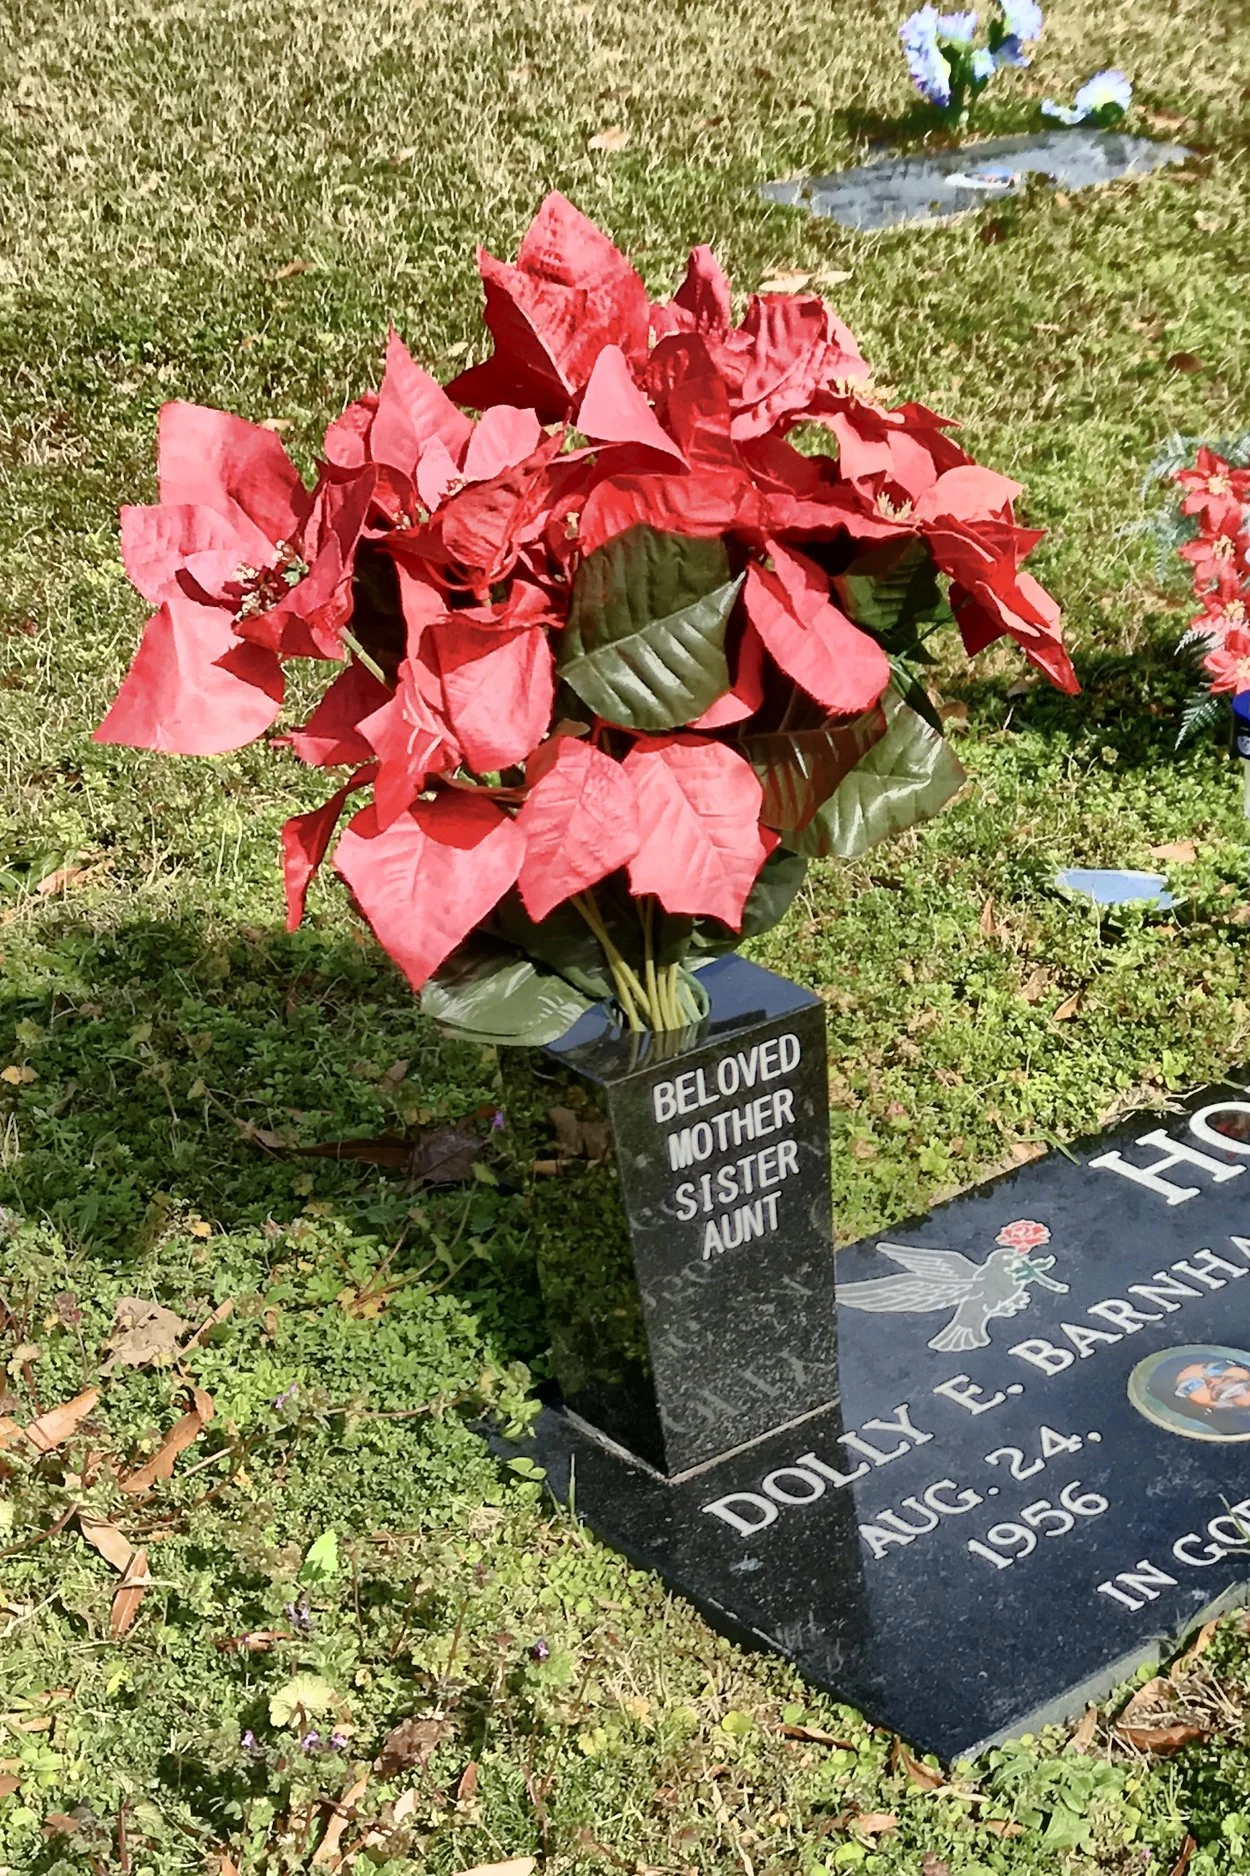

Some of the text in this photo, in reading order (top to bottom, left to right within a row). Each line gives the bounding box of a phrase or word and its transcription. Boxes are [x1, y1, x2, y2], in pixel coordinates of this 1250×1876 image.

[652, 1032, 801, 1124] BELOVED
[668, 1088, 796, 1172] MOTHER
[675, 1139, 800, 1221] SISTER
[702, 1190, 782, 1261] AUNT
[702, 1402, 934, 1538] DOLLY
[932, 1373, 1025, 1416] E.
[858, 1479, 1001, 1560] AUG.
[967, 1480, 1110, 1569] 1956
[1097, 1558, 1179, 1612] IN
